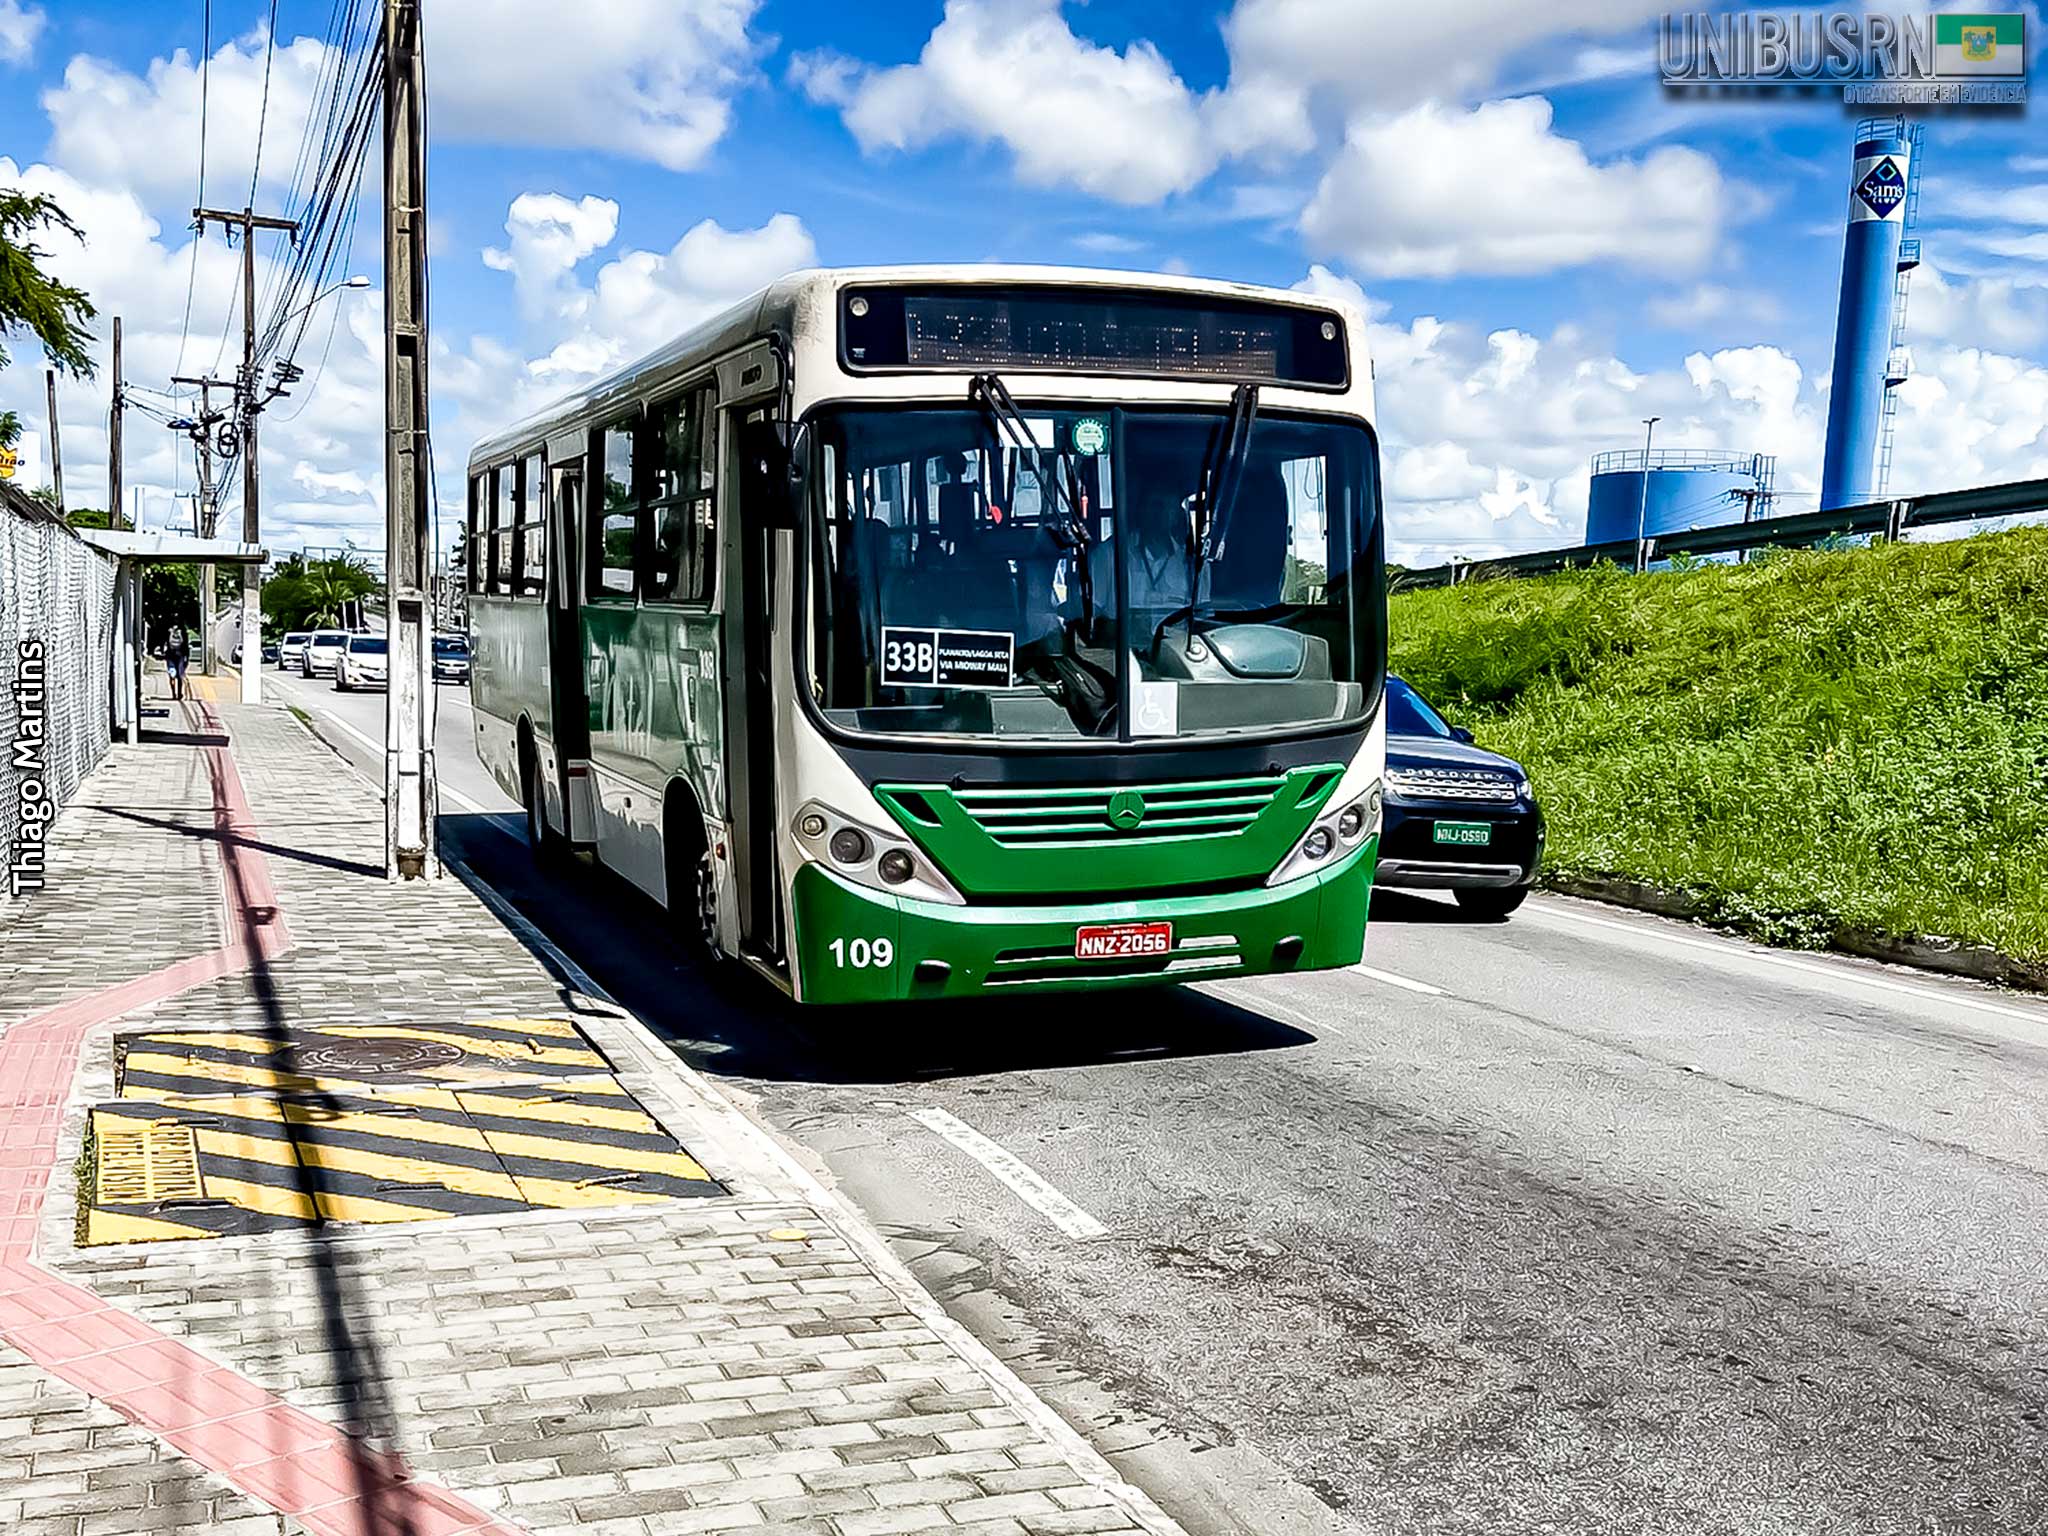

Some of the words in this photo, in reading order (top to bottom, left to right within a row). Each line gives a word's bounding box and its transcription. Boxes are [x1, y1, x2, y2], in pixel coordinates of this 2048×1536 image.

[1863, 181, 1903, 199] Sam's
[887, 641, 933, 672] 33B
[940, 660, 953, 670] VIA
[1405, 768, 1504, 781] DISCOVERY
[828, 937, 894, 968] 109
